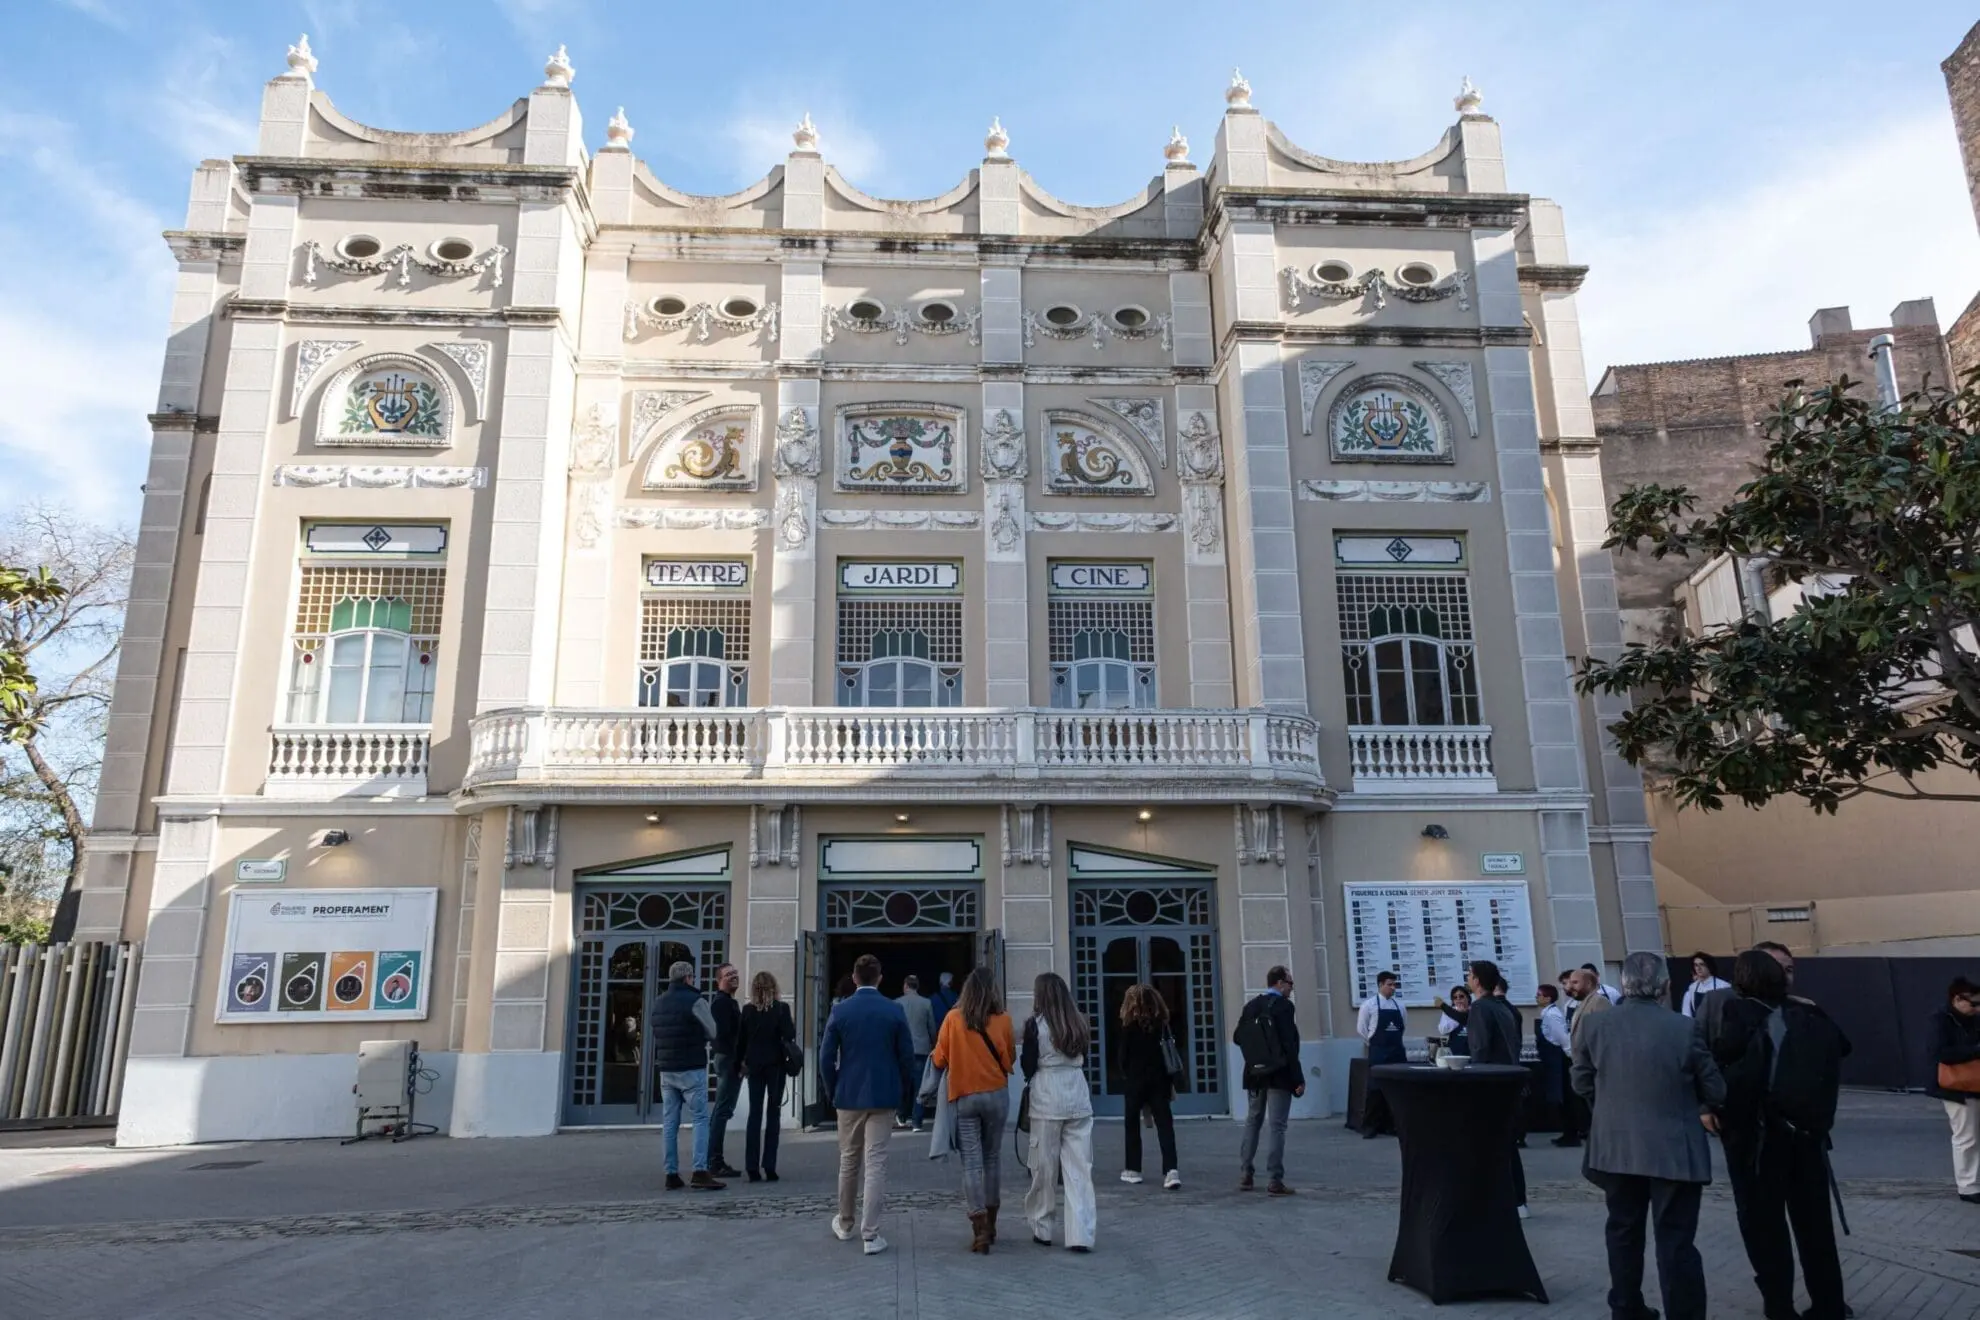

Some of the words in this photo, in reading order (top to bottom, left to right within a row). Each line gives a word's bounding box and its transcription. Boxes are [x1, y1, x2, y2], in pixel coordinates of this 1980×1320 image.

[654, 564, 741, 582] TEATRE
[863, 564, 939, 584] JARDÍ
[1071, 568, 1130, 585] CINE
[312, 905, 390, 915] PROPERAMENT
